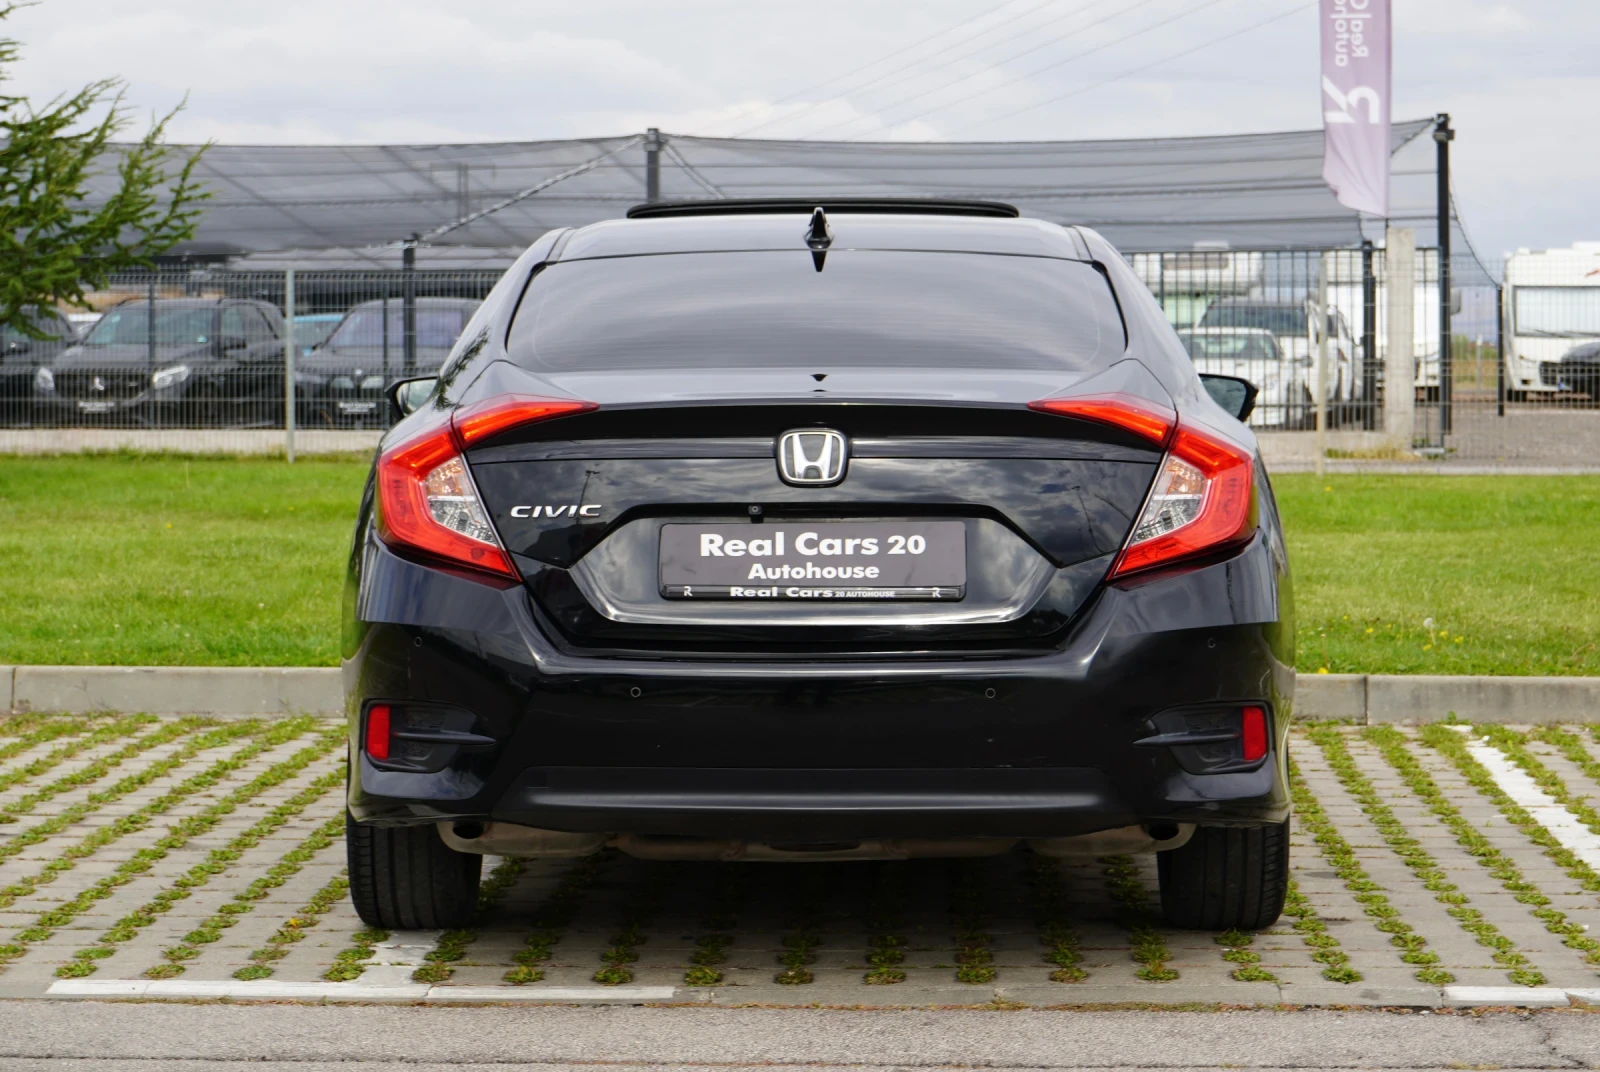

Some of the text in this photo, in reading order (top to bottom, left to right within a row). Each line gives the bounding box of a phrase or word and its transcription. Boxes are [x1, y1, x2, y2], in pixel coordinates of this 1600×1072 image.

[510, 504, 602, 518] CIVIC
[700, 532, 927, 557] Real Cars 20
[747, 562, 880, 579] Autohouse
[729, 586, 896, 598] Real Cars 20 AUTOHOUSE
